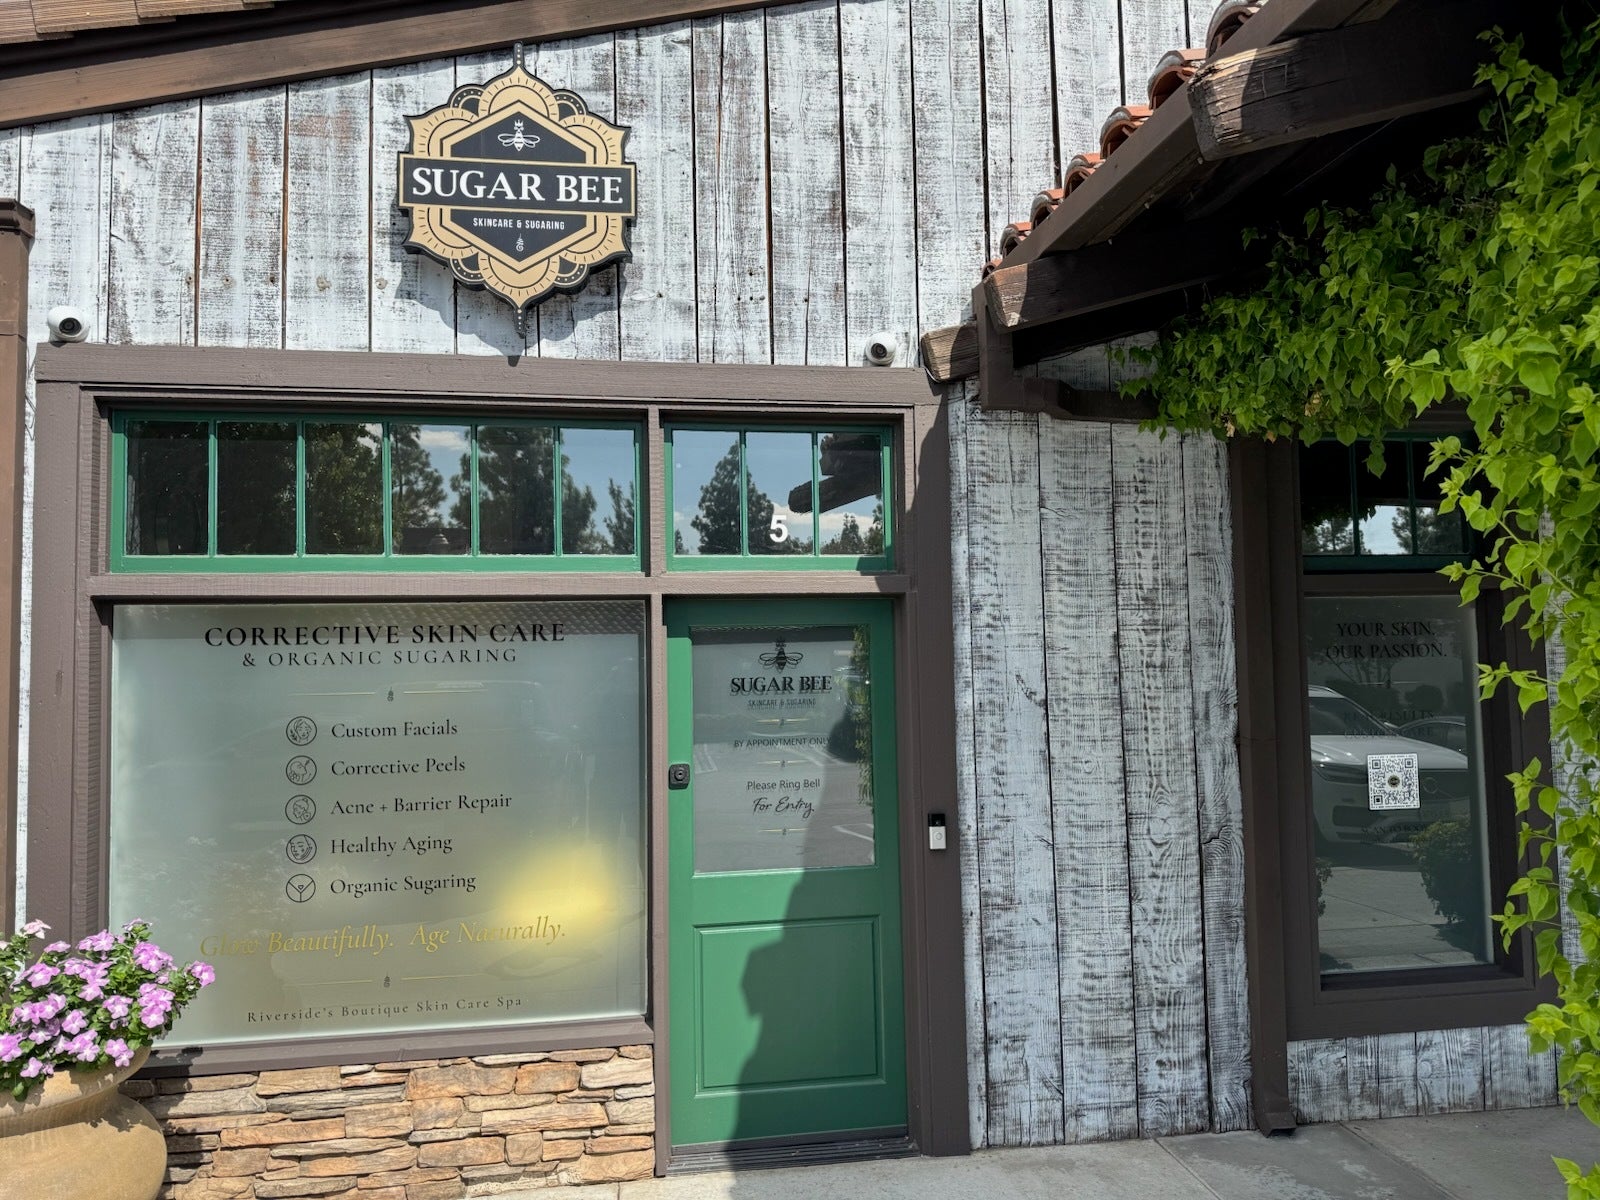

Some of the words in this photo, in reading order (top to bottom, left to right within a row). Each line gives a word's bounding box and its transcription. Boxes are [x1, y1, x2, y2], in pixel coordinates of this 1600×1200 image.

[412, 166, 545, 201] SUGAR
[556, 174, 623, 204] BEE
[473, 217, 513, 228] SKINCARE
[516, 218, 522, 229] &
[525, 218, 565, 230] SUGARING
[769, 515, 789, 543] 5
[204, 625, 400, 647] CORRECTIVE
[411, 624, 479, 644] SKIN
[489, 623, 565, 642] CARE
[1337, 622, 1388, 637] YOUR
[1391, 622, 1435, 636] SKIN.
[242, 653, 257, 667] &
[268, 650, 382, 667] ORGANIC
[393, 648, 517, 665] SUGARING
[1326, 645, 1364, 659] OUR
[1370, 643, 1447, 658] PASSION.
[730, 676, 795, 693] SUGAR
[800, 675, 832, 691] BEE
[748, 699, 777, 707] SKINCARE
[331, 722, 397, 739] Custom
[403, 719, 458, 736] Facials
[734, 739, 745, 748] BY
[746, 738, 807, 747] APPOINTMENT
[331, 759, 420, 777] Corrective
[426, 756, 466, 773] Peels
[747, 780, 777, 790] Please
[779, 779, 800, 791] Ring
[804, 779, 820, 788] Bell
[330, 797, 374, 815] Acne
[379, 802, 388, 811] +
[393, 794, 452, 812] Barrier
[457, 793, 512, 812] Repair
[753, 797, 772, 812] For
[330, 836, 397, 857] Healthy
[403, 835, 453, 856] Aging
[330, 877, 398, 899] Organic
[403, 874, 477, 897] Sugaring
[199, 934, 261, 957] Glow
[267, 924, 395, 958] Beautifully.
[409, 924, 450, 953] Age
[457, 915, 566, 946] Naturally.
[247, 1006, 334, 1023] Riverside's
[341, 1003, 409, 1018] Boutique
[416, 1000, 449, 1012] Skin
[456, 998, 490, 1010] Care
[497, 996, 523, 1011] Spa
